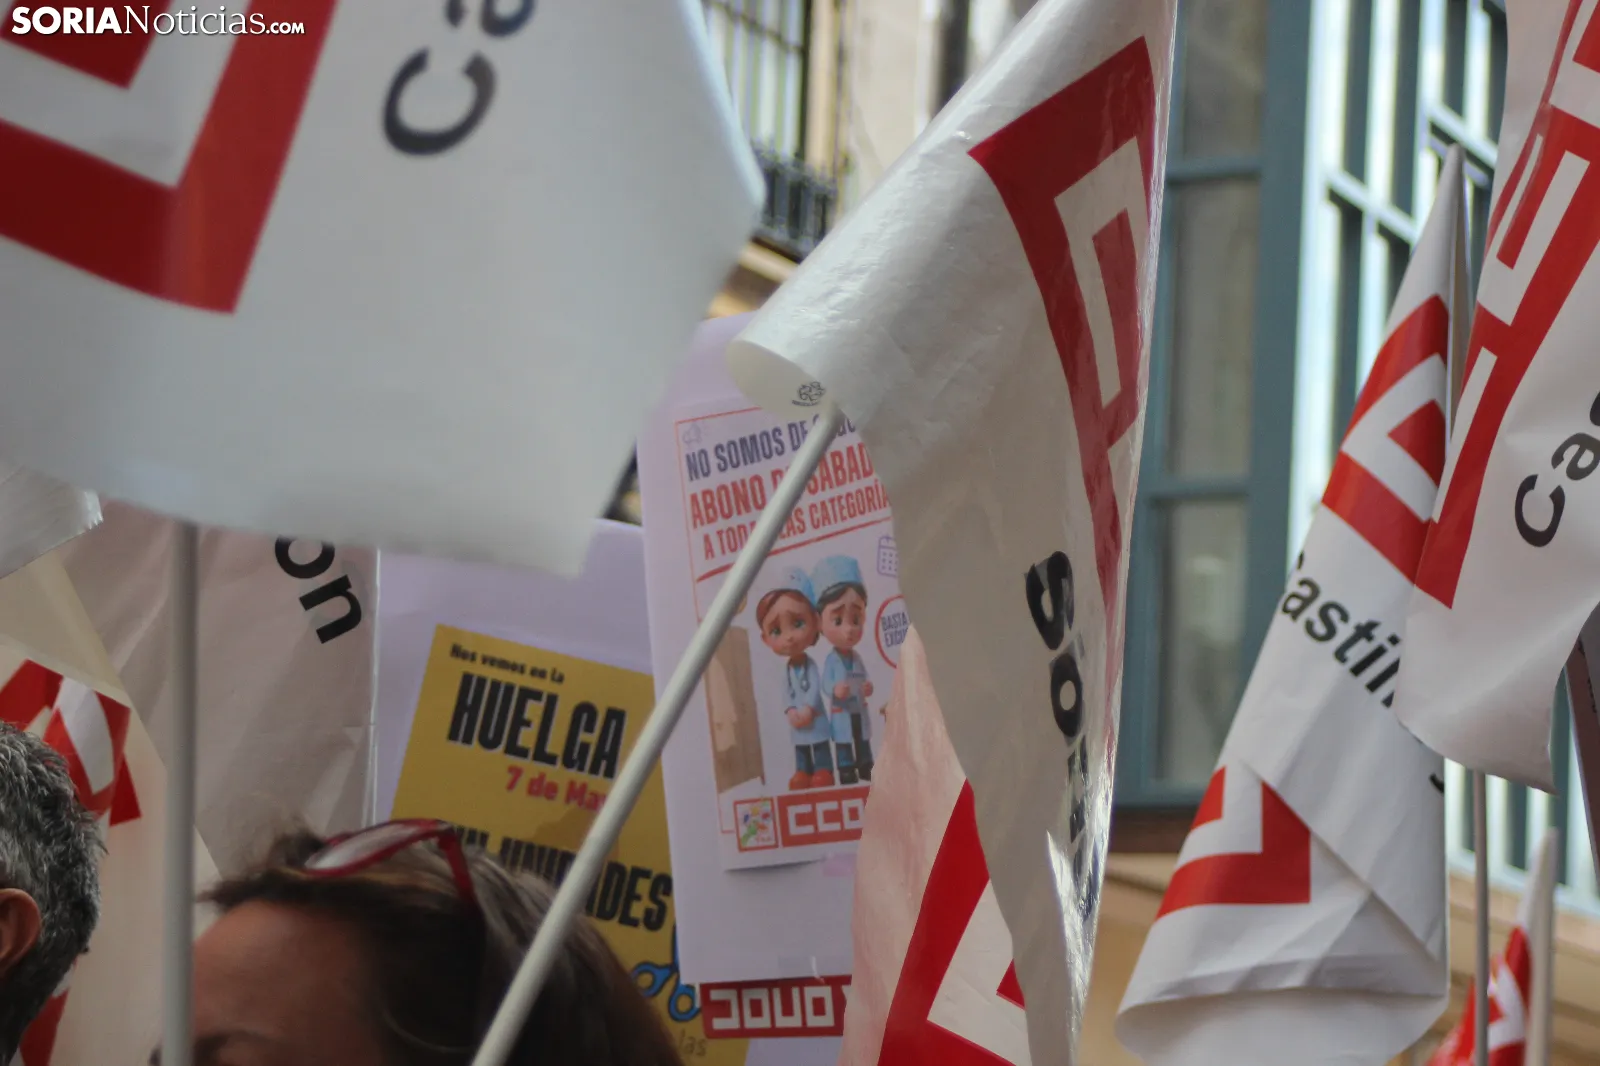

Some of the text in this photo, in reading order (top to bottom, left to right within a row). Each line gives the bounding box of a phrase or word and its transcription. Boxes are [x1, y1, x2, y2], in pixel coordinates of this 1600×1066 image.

[686, 449, 711, 482] NO
[714, 427, 785, 473] SOMOS
[1514, 390, 1600, 548] Ca
[690, 474, 767, 529] ABONO
[703, 533, 715, 560] A
[1281, 551, 1400, 709] astil
[450, 643, 477, 662] Nos
[481, 653, 526, 675] vemos
[530, 666, 547, 679] en
[447, 671, 627, 779] HUELGA
[506, 765, 608, 813] 7 de Ma
